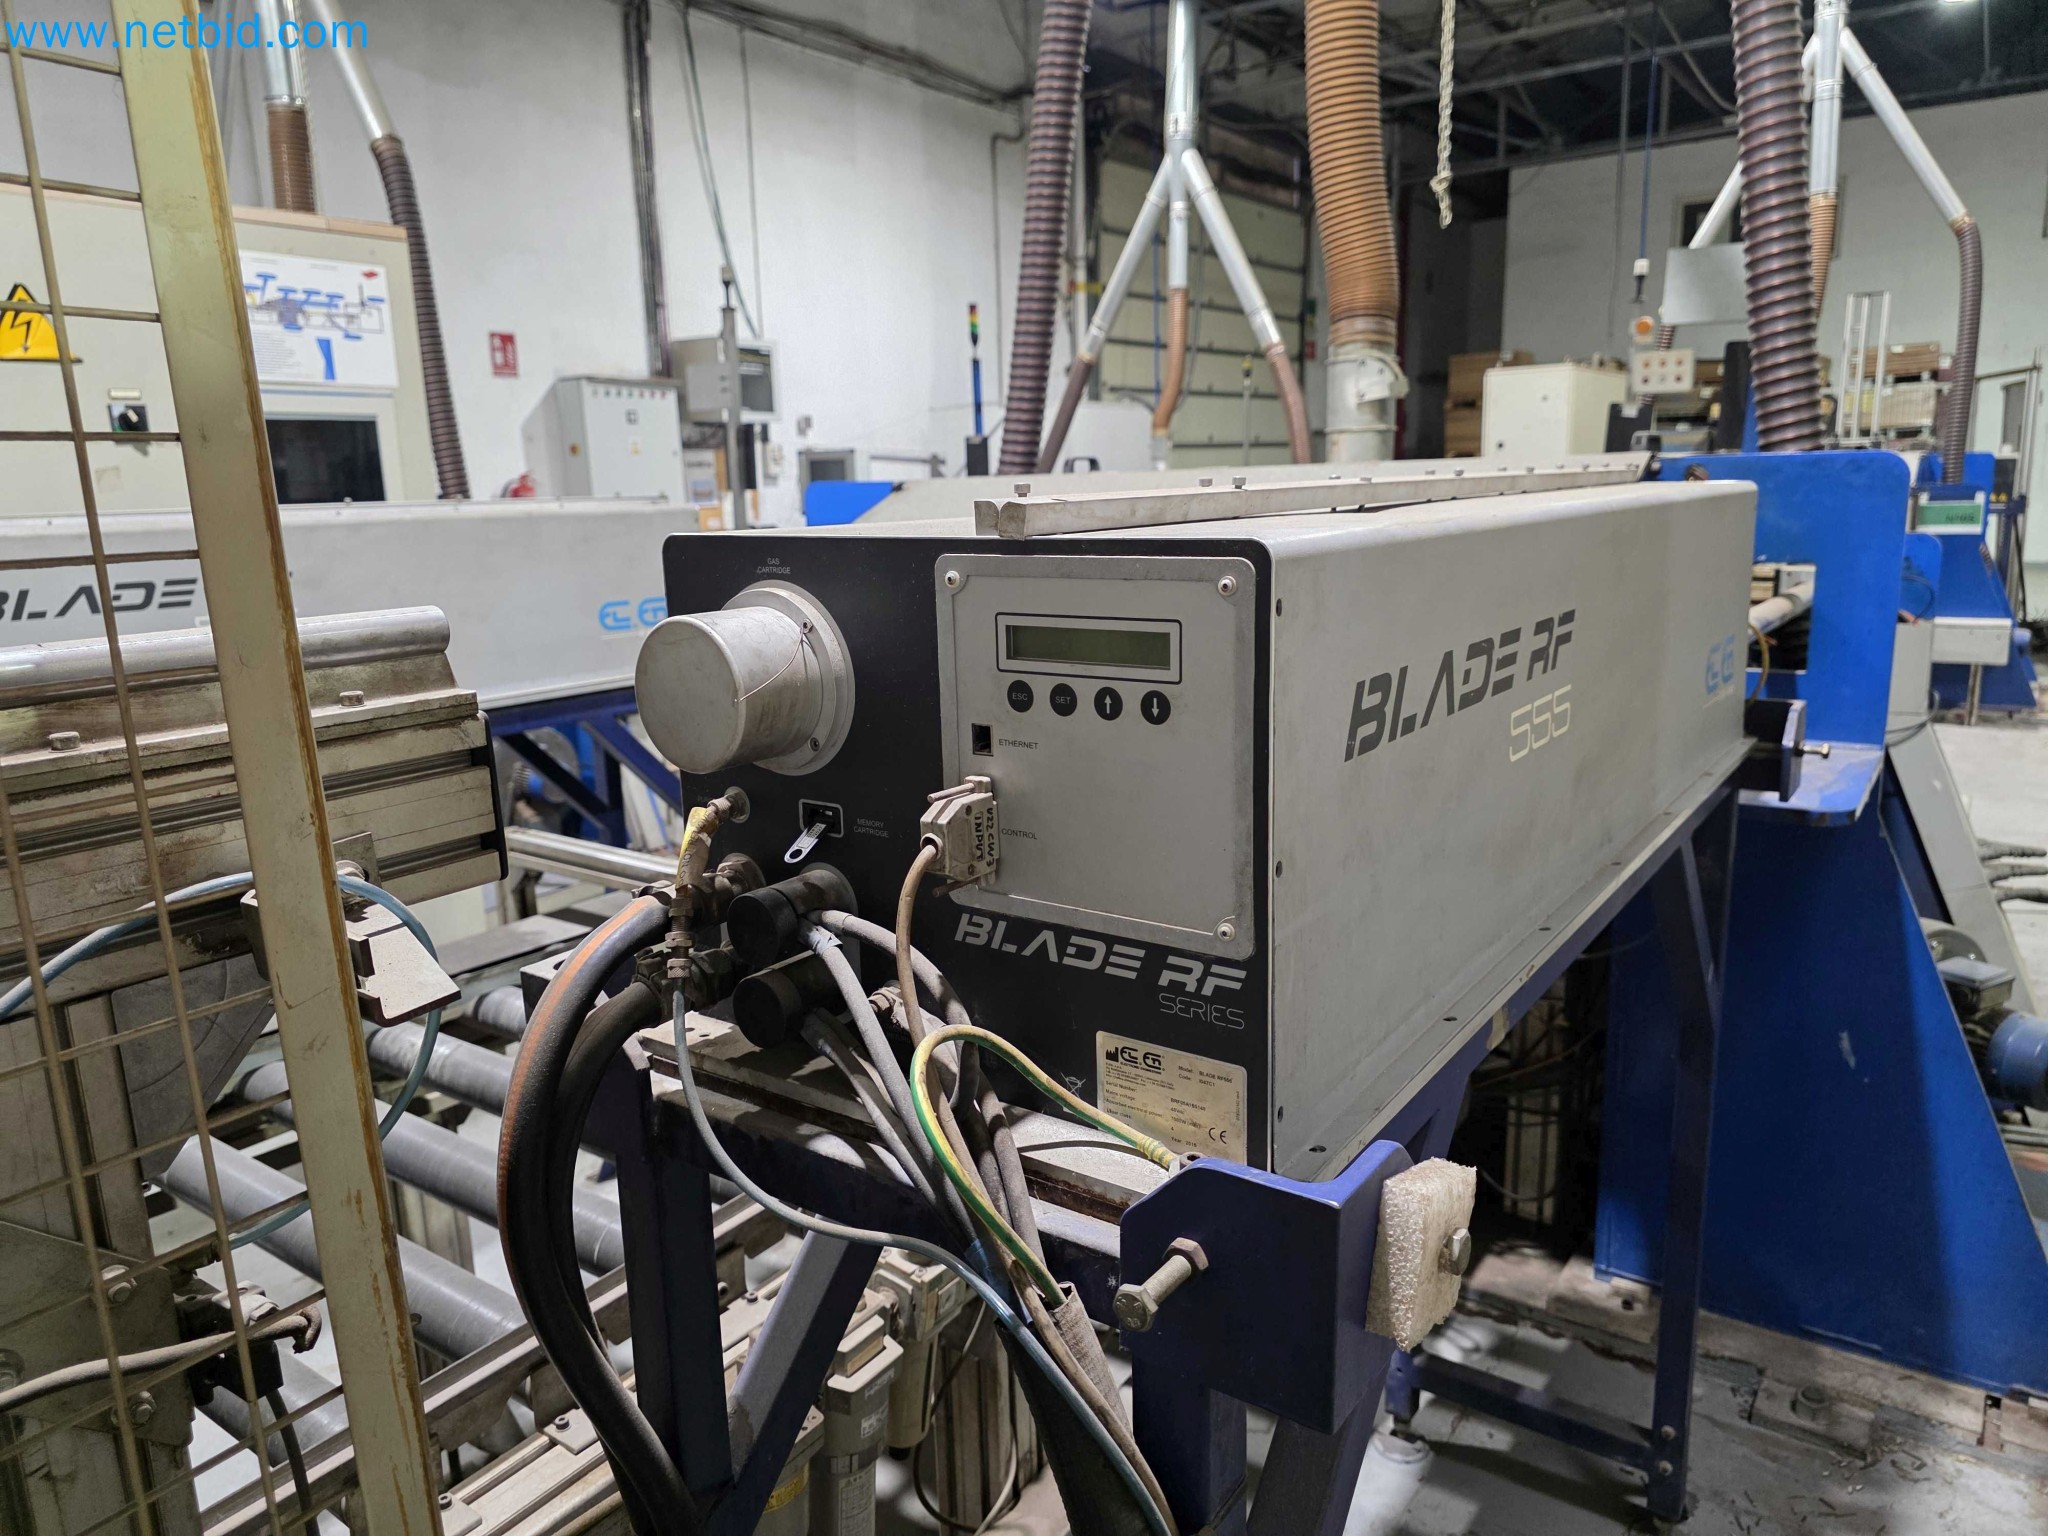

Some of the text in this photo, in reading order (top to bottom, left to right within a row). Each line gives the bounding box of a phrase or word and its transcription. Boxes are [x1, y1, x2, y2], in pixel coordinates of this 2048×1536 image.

[767, 557, 781, 565] GAS
[757, 566, 791, 574] CARTRIDGE
[0, 579, 198, 621] LADE
[1344, 608, 1576, 762] BLADE RF
[1012, 692, 1028, 702] ESC
[1055, 696, 1071, 705] SET
[998, 738, 1040, 751] ETHERNET
[857, 818, 885, 828] MEMORY
[853, 826, 889, 838] CARTRIDGE
[1001, 828, 1038, 840] CONTROL
[974, 815, 984, 862] INPUT
[954, 913, 1248, 997] BLADE RF
[1158, 993, 1245, 1030] SERIES
[1199, 1070, 1216, 1080] BLADE
